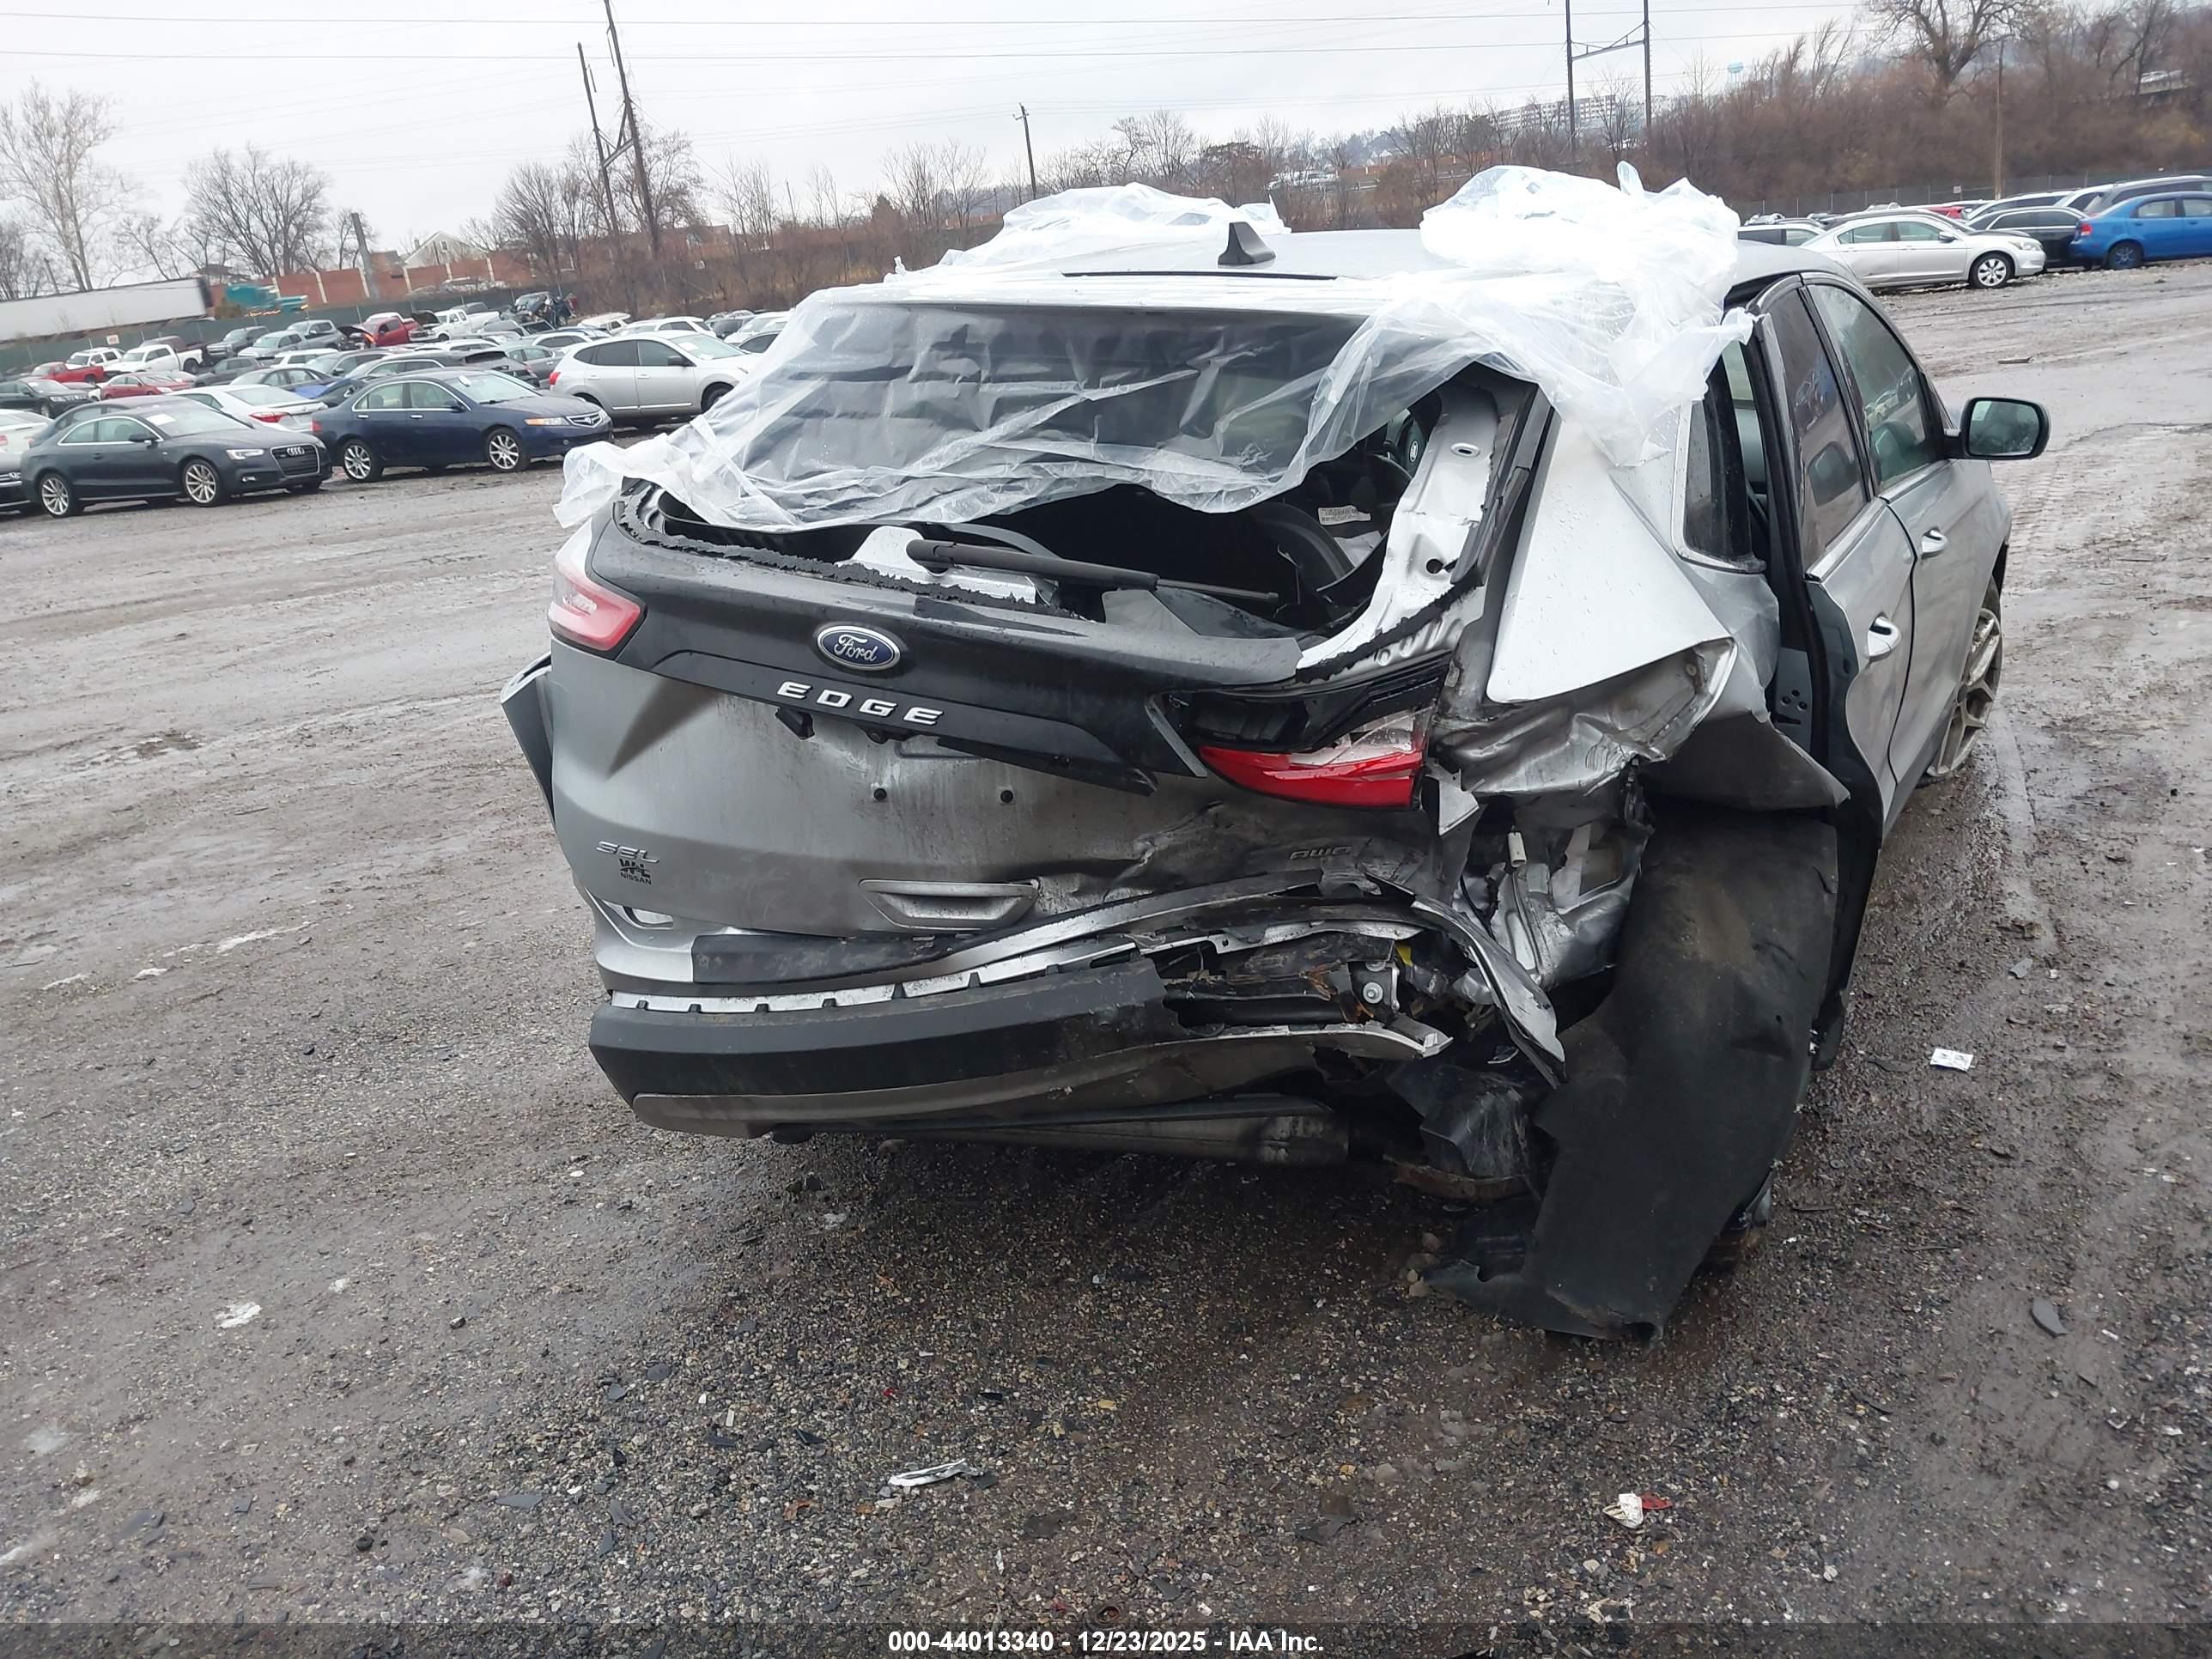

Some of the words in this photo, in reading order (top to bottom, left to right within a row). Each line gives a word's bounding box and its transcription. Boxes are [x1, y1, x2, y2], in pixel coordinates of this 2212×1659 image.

[834, 634, 878, 661] Ford
[777, 681, 944, 725] EDGE
[596, 841, 659, 863] SEL
[620, 872, 652, 885] NISSAN
